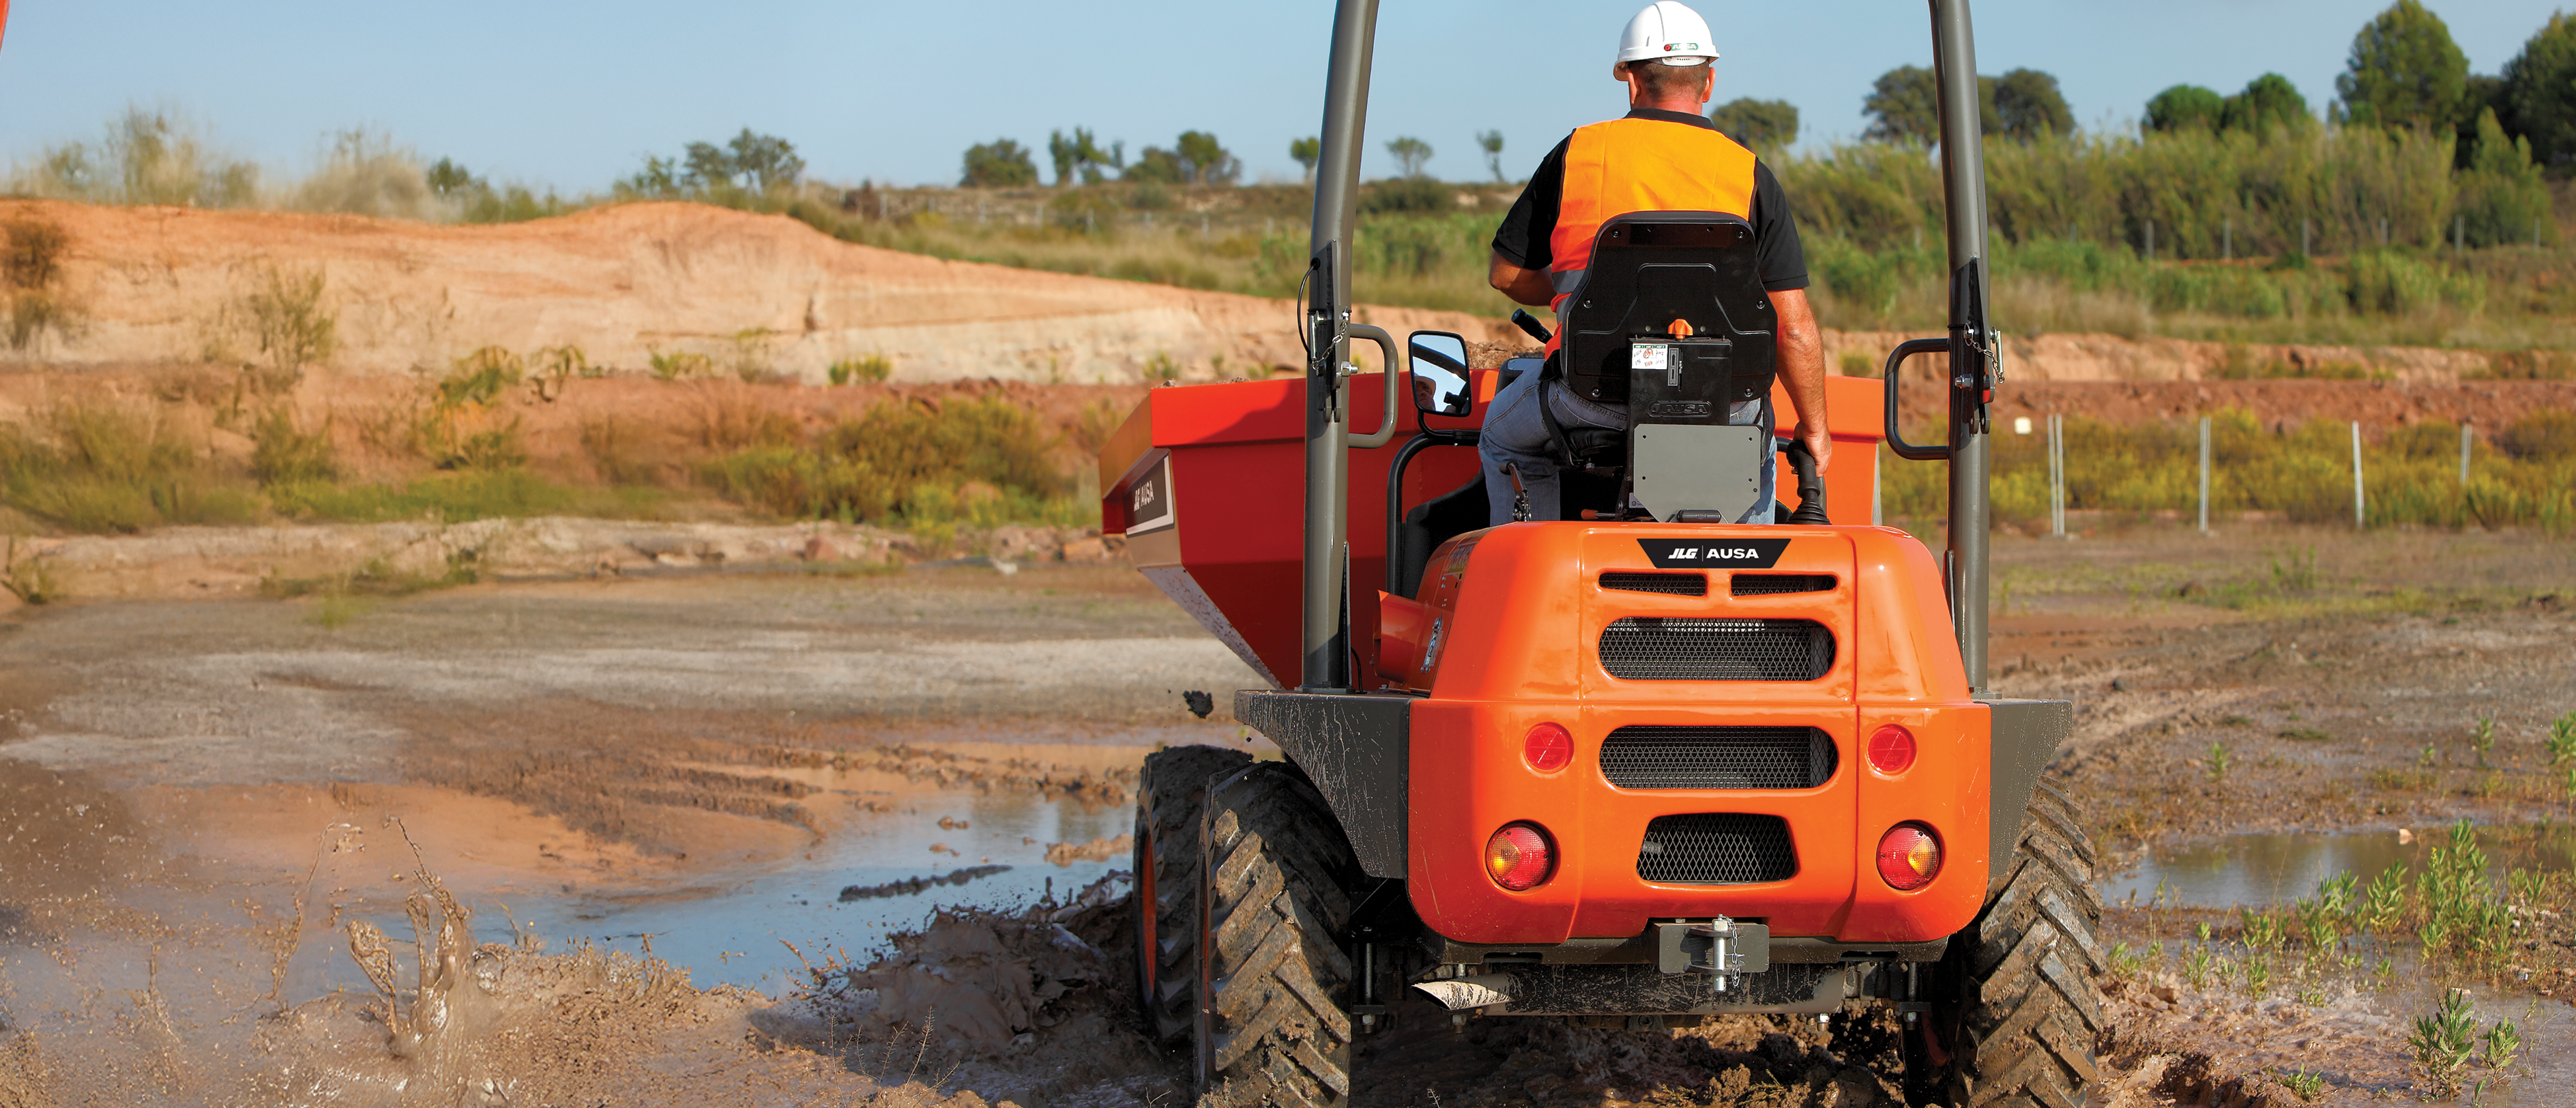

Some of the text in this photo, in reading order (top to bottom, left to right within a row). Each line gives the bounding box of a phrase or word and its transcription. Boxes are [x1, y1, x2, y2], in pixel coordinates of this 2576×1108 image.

[1660, 405, 1708, 413] AUSA
[1141, 480, 1154, 507] AUSA
[1668, 548, 1759, 559] JLG AUSA
